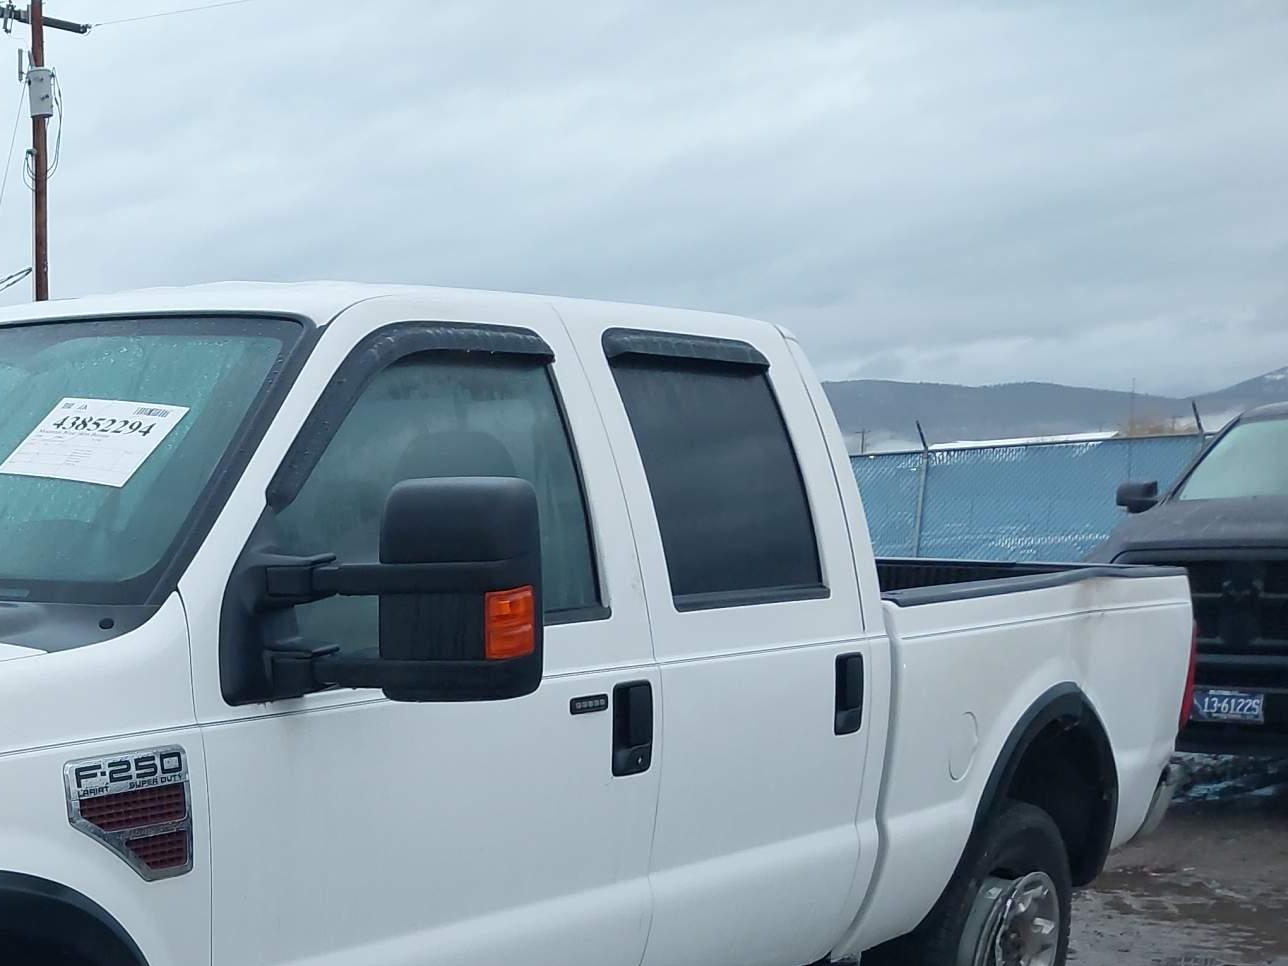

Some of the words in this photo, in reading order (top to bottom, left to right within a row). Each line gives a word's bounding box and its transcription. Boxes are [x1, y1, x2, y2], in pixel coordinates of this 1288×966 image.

[52, 415, 158, 437] 43852294
[74, 751, 183, 789] F-250
[128, 776, 159, 790] SUPER
[160, 773, 183, 784] DUTY
[77, 785, 110, 798] LARIAT
